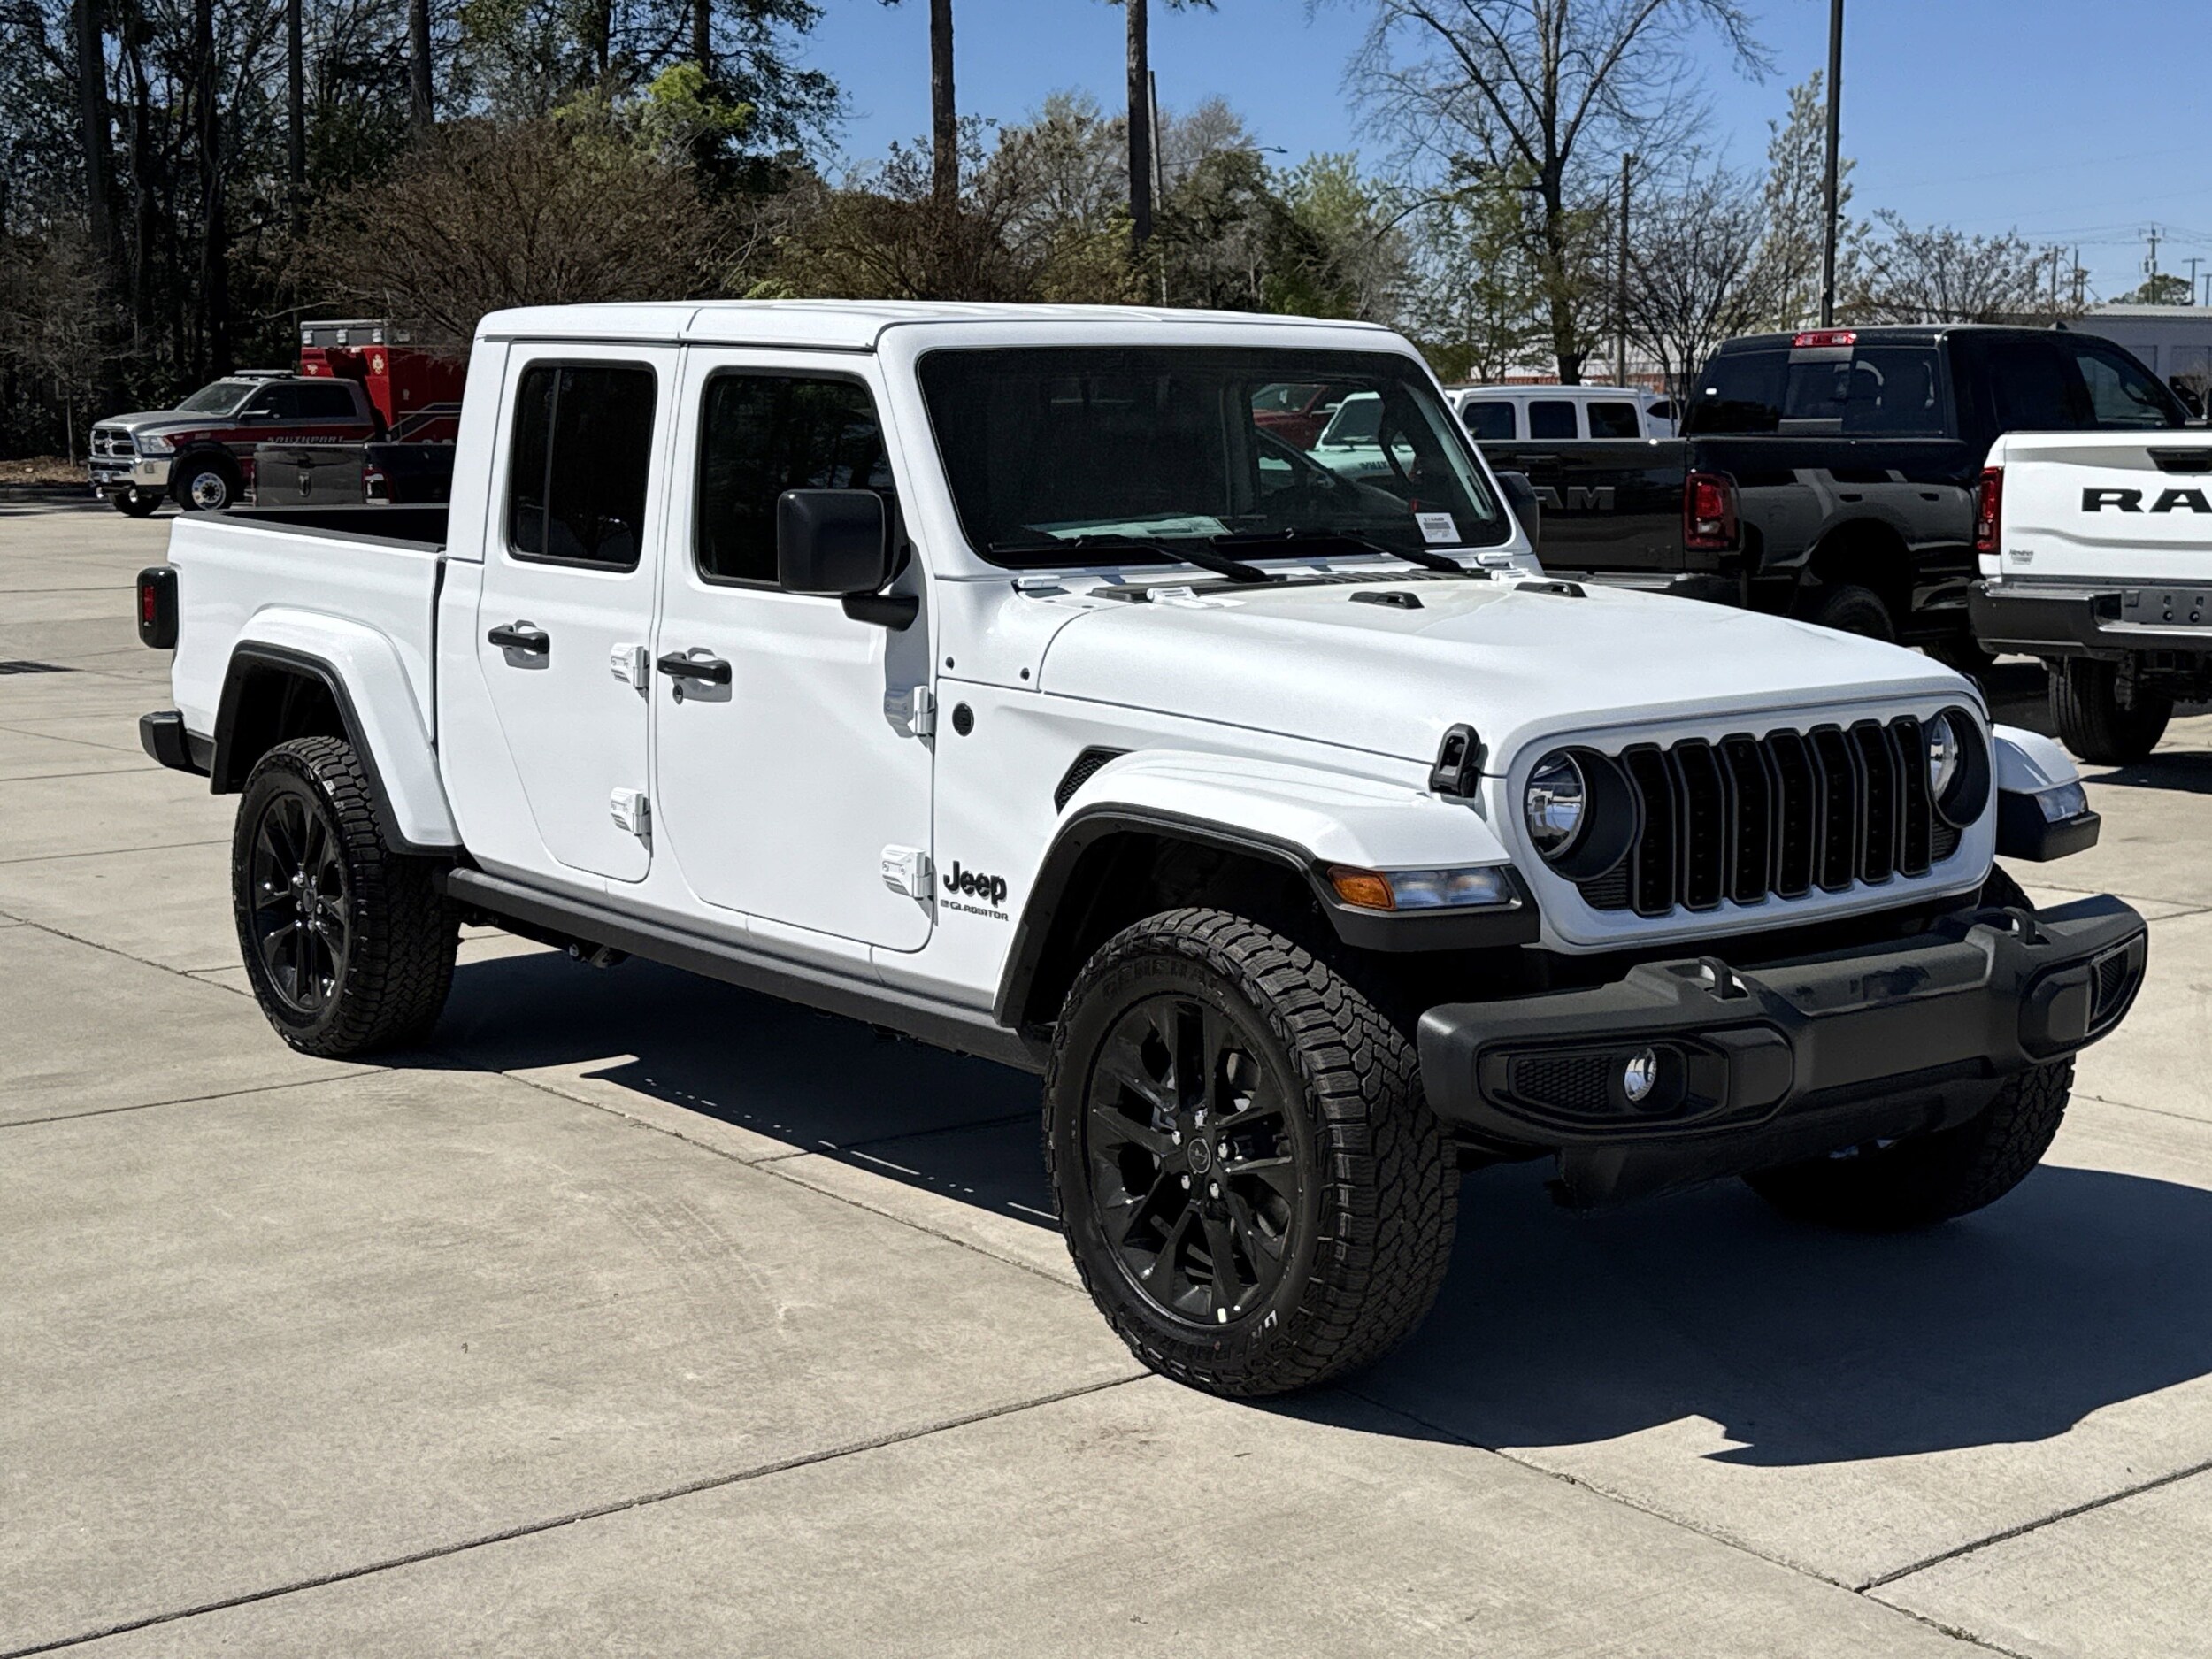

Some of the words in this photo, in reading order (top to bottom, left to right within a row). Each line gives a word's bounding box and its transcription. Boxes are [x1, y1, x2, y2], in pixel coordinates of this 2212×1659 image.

[1532, 485, 1617, 511] AM
[2081, 487, 2212, 513] RA
[943, 860, 1008, 908] Jeep
[950, 901, 1009, 921] GLADIATOR
